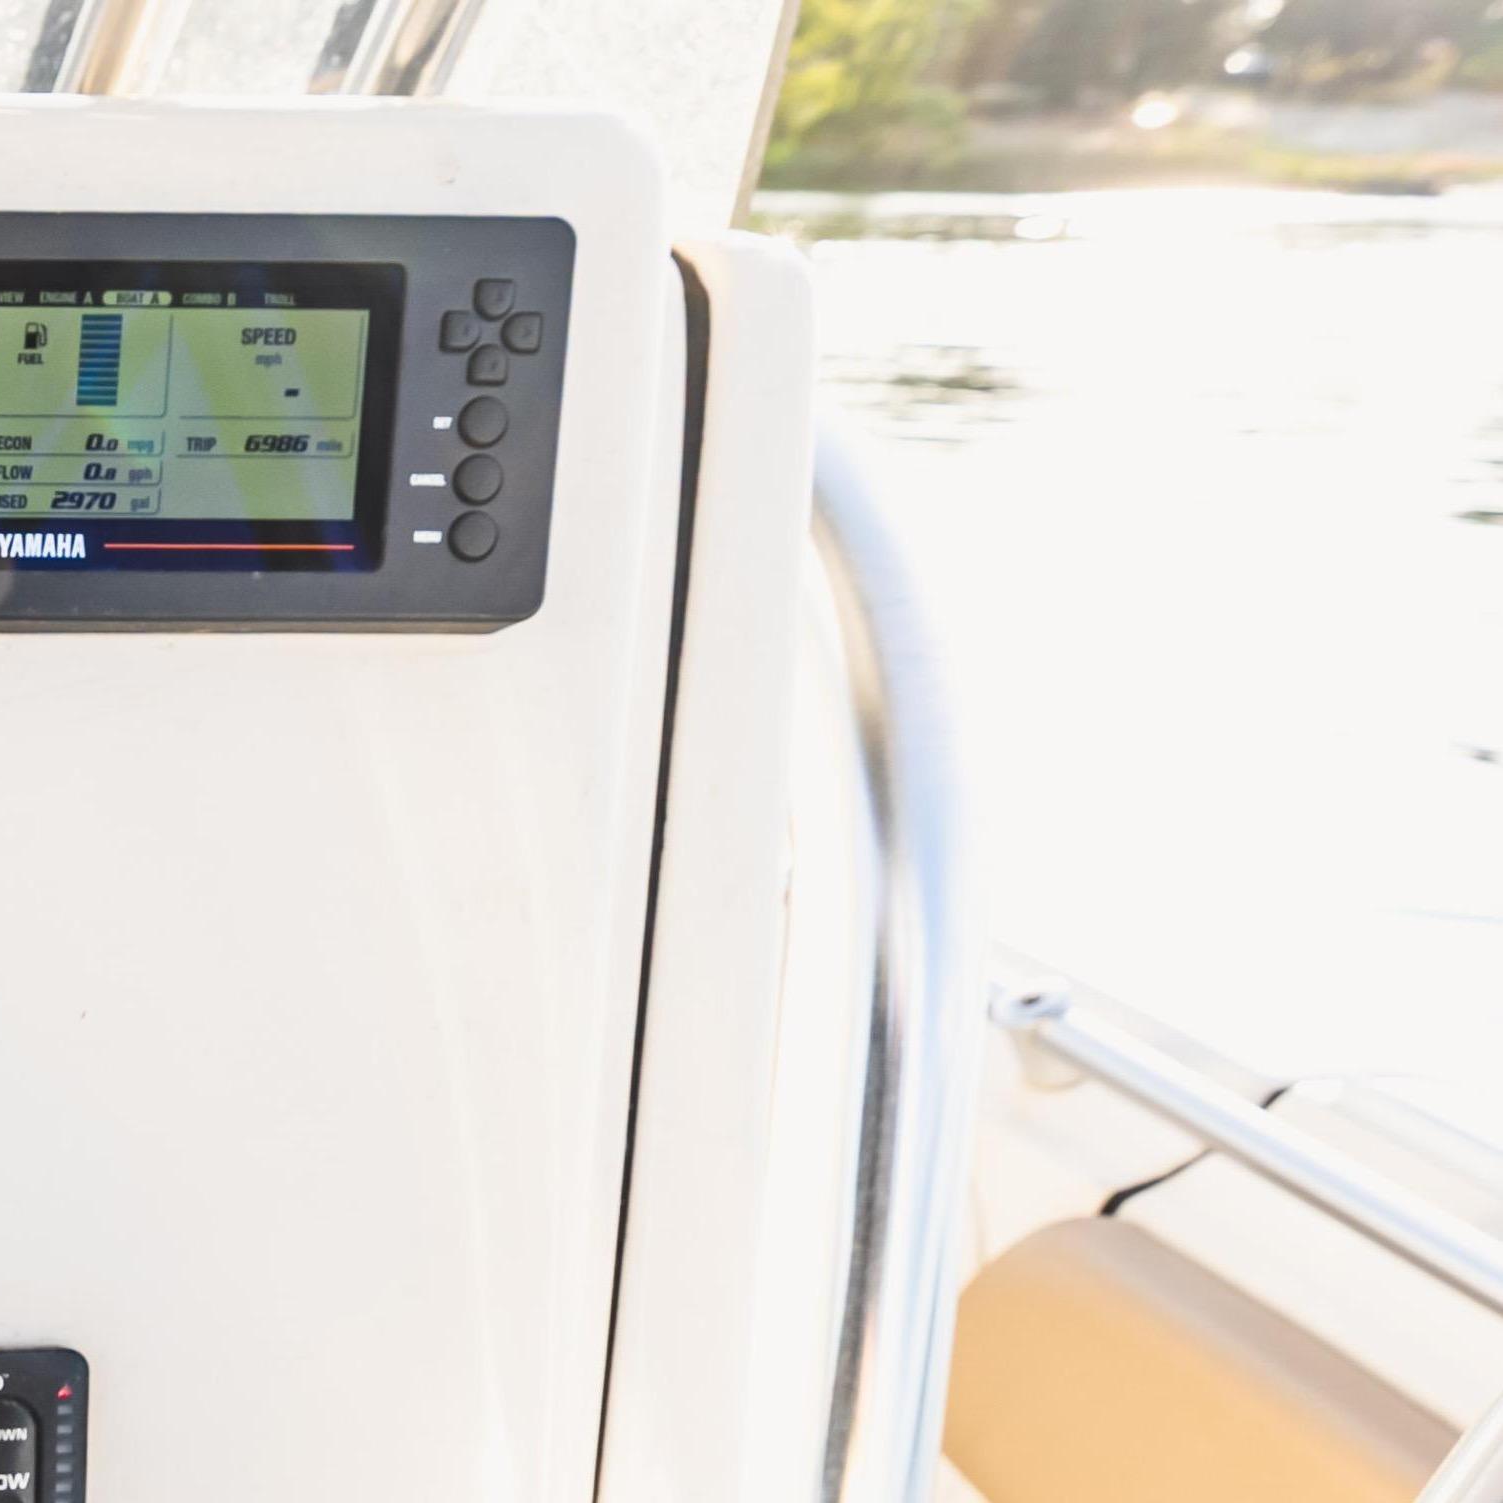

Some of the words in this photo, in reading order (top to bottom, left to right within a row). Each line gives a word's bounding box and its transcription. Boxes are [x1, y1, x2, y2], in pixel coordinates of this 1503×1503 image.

[241, 327, 297, 347] SPEED
[17, 353, 44, 366] FUEL
[255, 353, 282, 368] mph
[186, 436, 217, 453] TRIP
[243, 434, 310, 453] 6986
[50, 491, 117, 511] 2970
